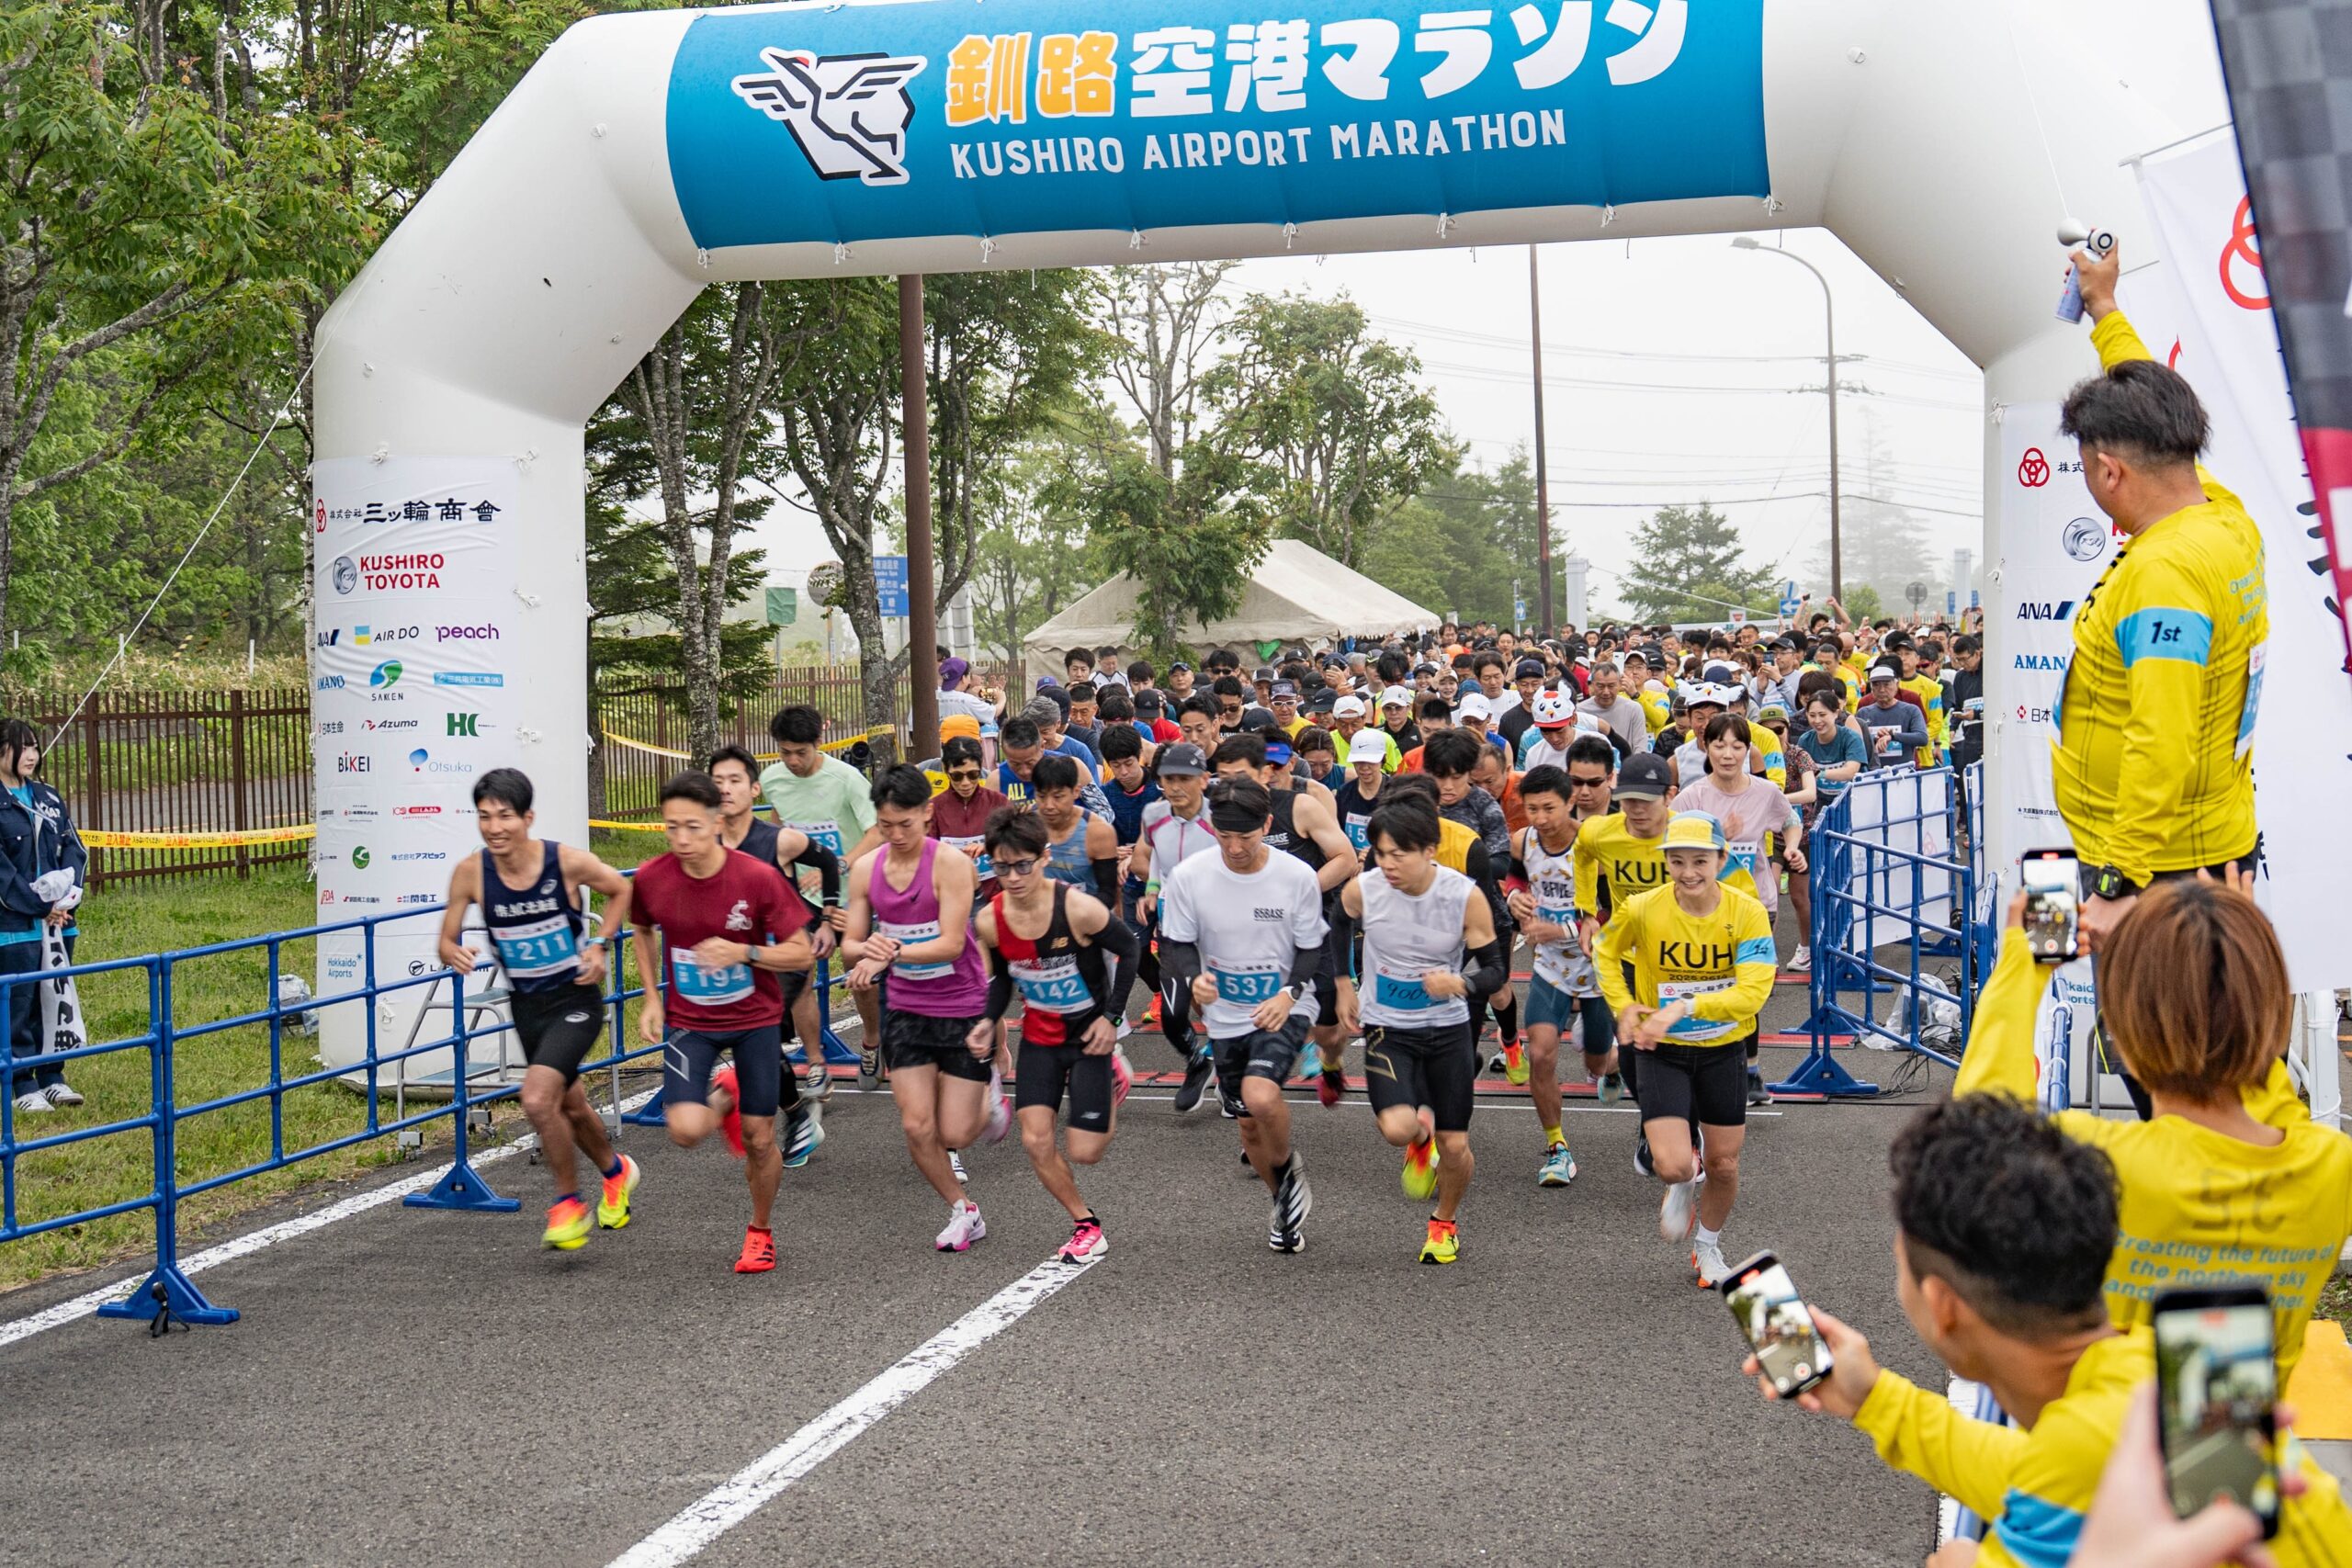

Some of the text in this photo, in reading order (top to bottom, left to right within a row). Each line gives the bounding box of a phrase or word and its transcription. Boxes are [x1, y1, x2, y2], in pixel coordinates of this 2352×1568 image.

[945, 0, 1689, 127] 釧路空港マラソン
[950, 108, 1566, 179] KUSHIRO AIRPORT MARATHON
[360, 553, 445, 571] KUSHIRO
[364, 573, 441, 591] TOYOTA
[2017, 603, 2052, 621] ANA
[435, 623, 500, 643] peach
[2151, 621, 2182, 644] 1st
[2014, 654, 2066, 671] AMAN
[378, 719, 418, 729] Azuma
[2031, 708, 2052, 723] 日本
[428, 761, 472, 773] Otsuka
[1007, 783, 1027, 801] ALL
[105, 834, 131, 846] 立入禁止
[165, 836, 189, 846] 立入禁止
[516, 933, 568, 961] 211
[1659, 941, 1734, 969] KUH
[328, 957, 356, 968] Hokkaido
[327, 968, 354, 979] Airports
[696, 963, 747, 987] 194
[1033, 978, 1082, 999] 142
[1225, 976, 1275, 997] 537
[1387, 983, 1430, 1000] 900
[2218, 1244, 2254, 1263] the
[2258, 1247, 2316, 1263] future
[2129, 1258, 2170, 1279] the
[2278, 1270, 2309, 1290] sky
